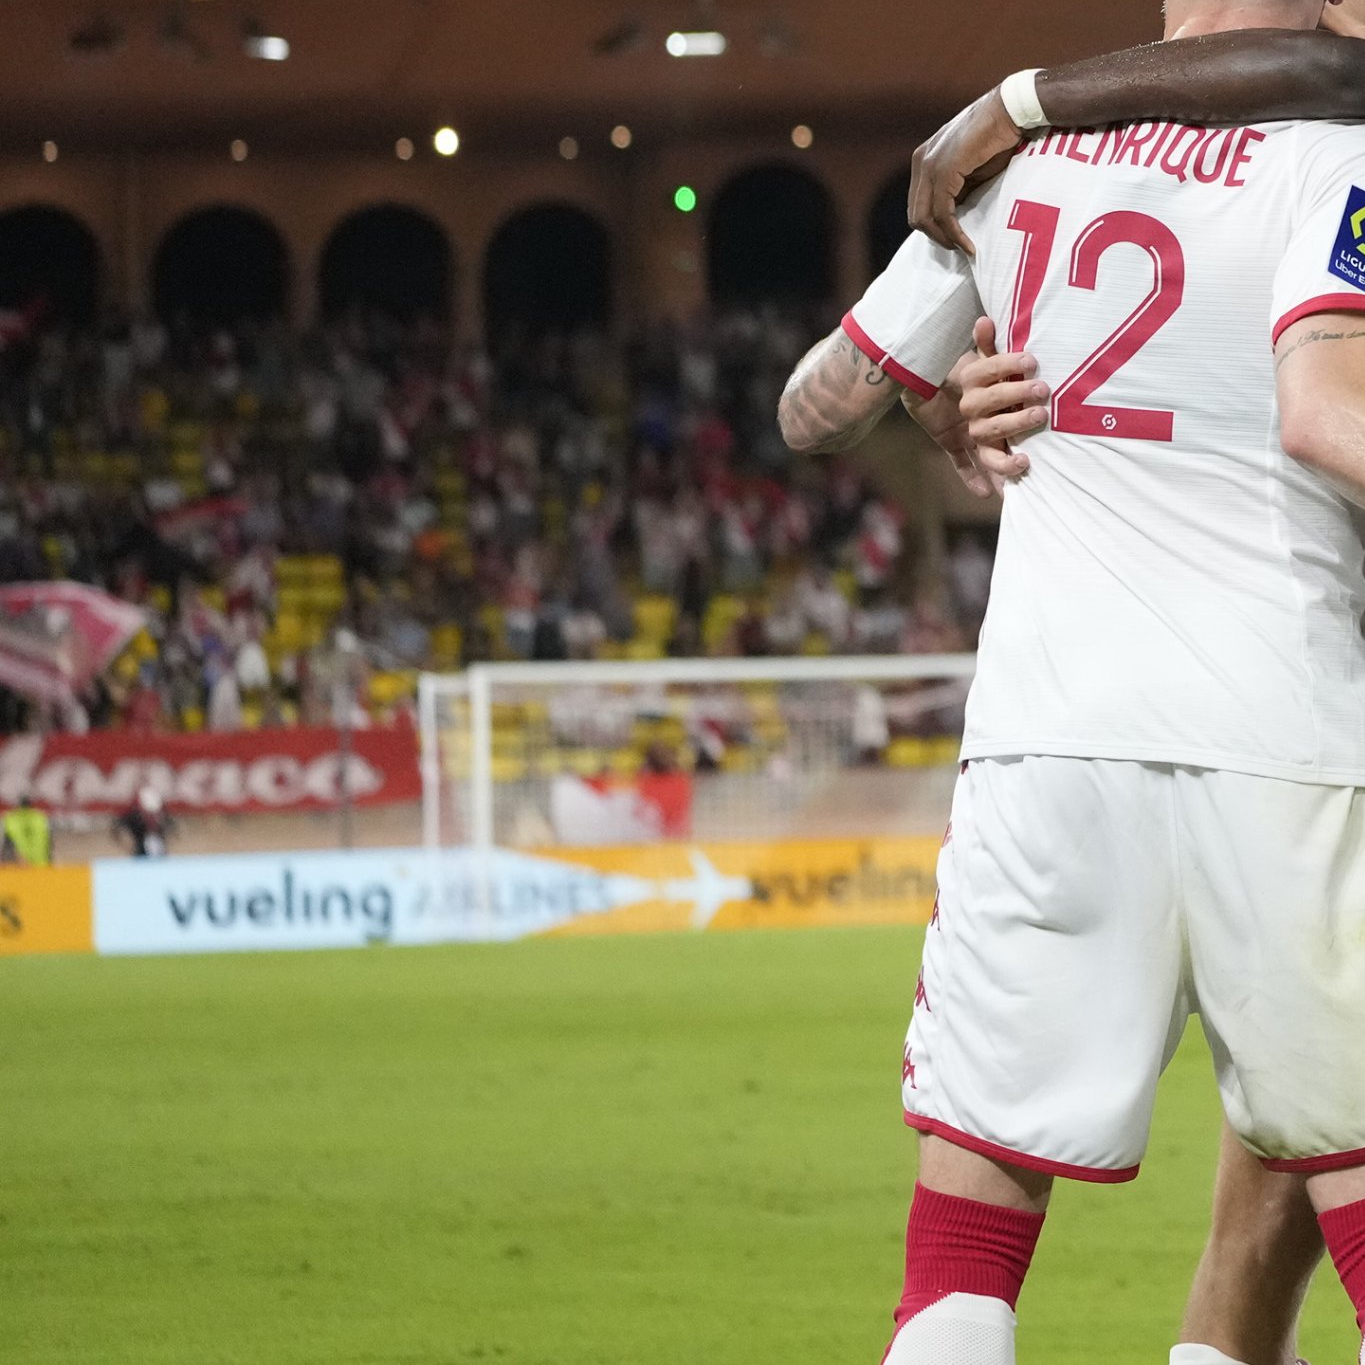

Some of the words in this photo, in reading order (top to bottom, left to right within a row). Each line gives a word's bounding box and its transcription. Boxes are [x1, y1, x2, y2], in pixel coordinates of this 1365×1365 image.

[1335, 259, 1357, 279] Uber
[1007, 199, 1185, 442] 12
[167, 868, 393, 945] vueling
